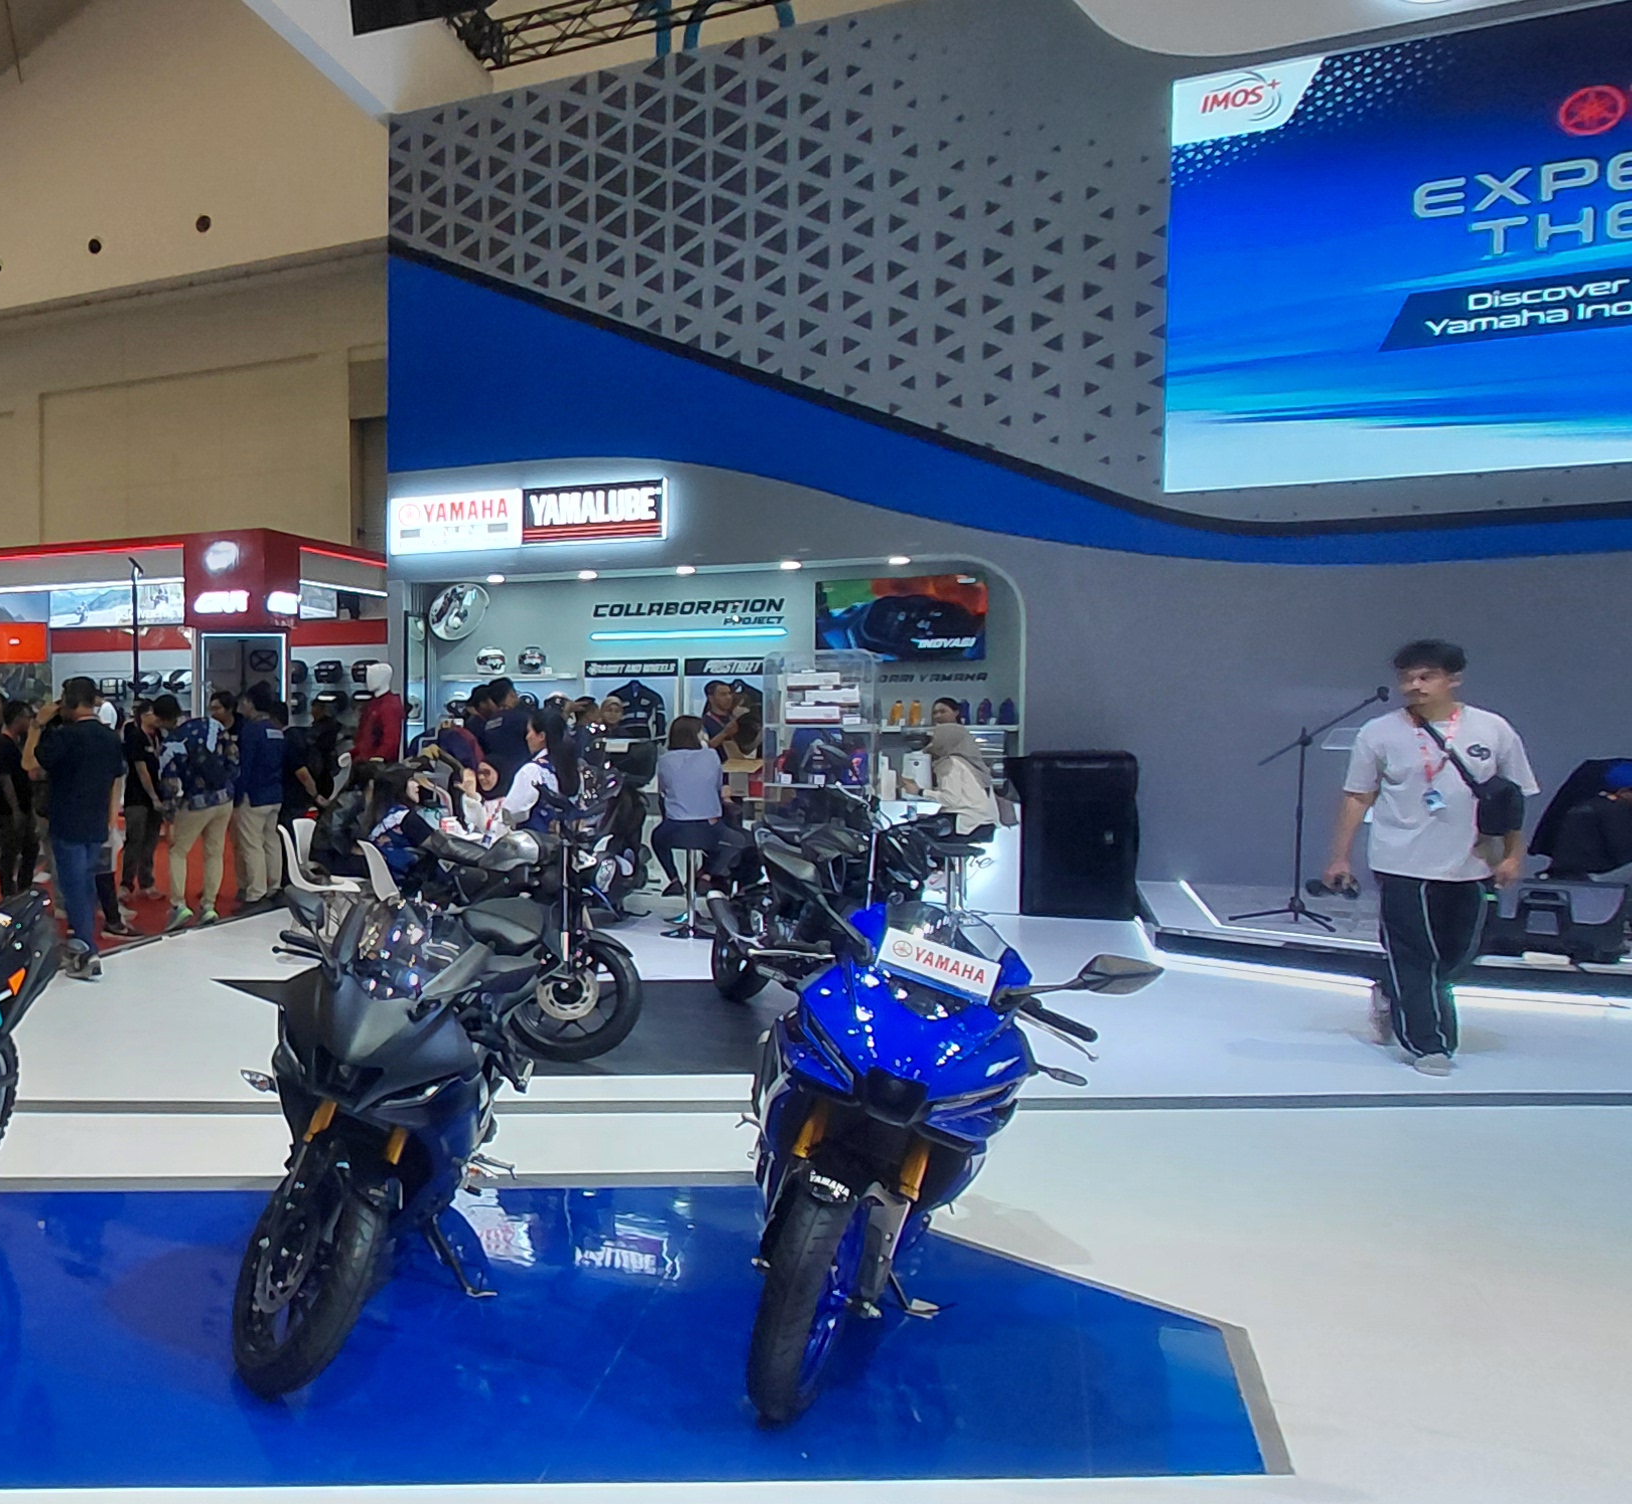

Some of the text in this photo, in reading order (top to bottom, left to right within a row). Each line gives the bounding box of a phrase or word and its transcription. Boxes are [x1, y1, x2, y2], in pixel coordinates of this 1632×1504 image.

[1467, 278, 1630, 312] Discover
[1425, 306, 1570, 337] Yamaha
[423, 497, 509, 523] YAMAHA
[529, 487, 657, 527] YAMALUBE
[593, 598, 786, 618] COLLABORATION
[723, 615, 785, 626] PROJECT
[918, 637, 976, 649] INOVASI
[878, 674, 915, 683] DARI
[919, 672, 988, 683] YAMAHA
[914, 946, 986, 985] YAMAHA
